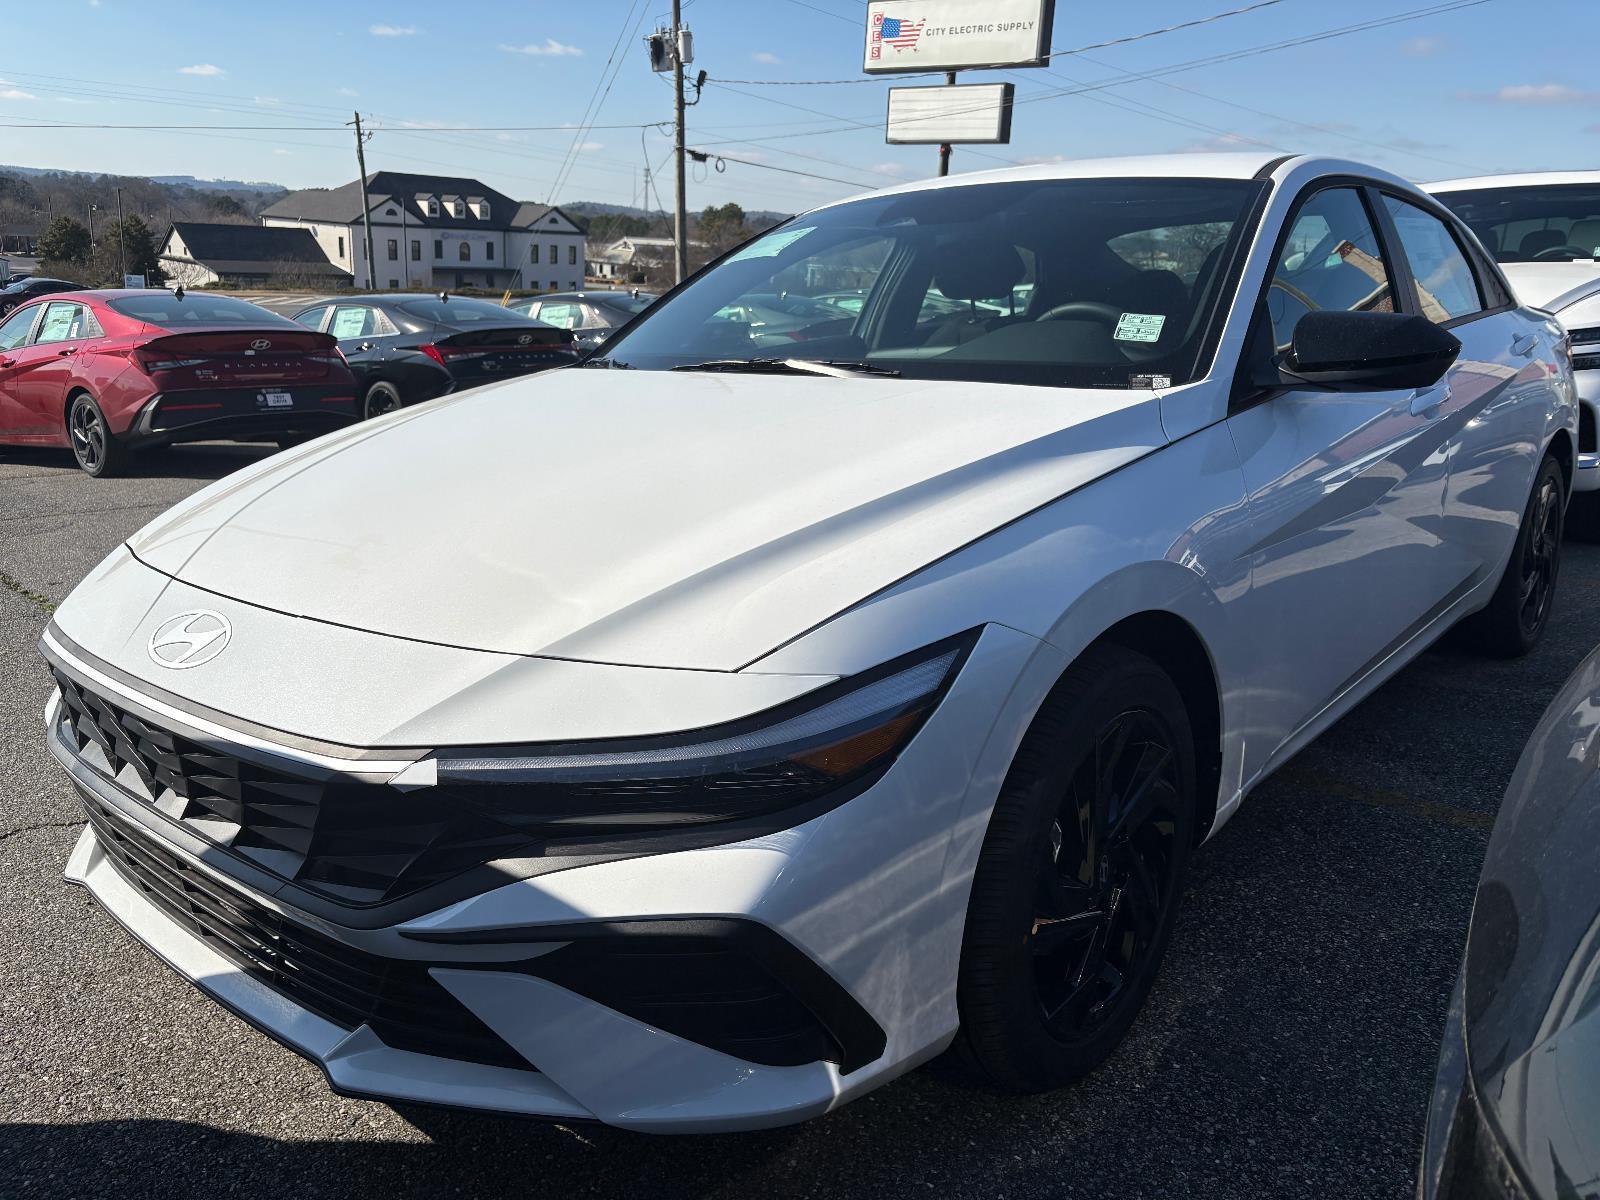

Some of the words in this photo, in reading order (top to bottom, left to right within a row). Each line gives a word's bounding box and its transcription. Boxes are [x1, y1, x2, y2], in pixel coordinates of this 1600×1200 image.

[872, 15, 883, 57] CES
[926, 27, 946, 37] CITY
[948, 24, 994, 35] ELECTRIC
[997, 21, 1034, 32] SUPPLY
